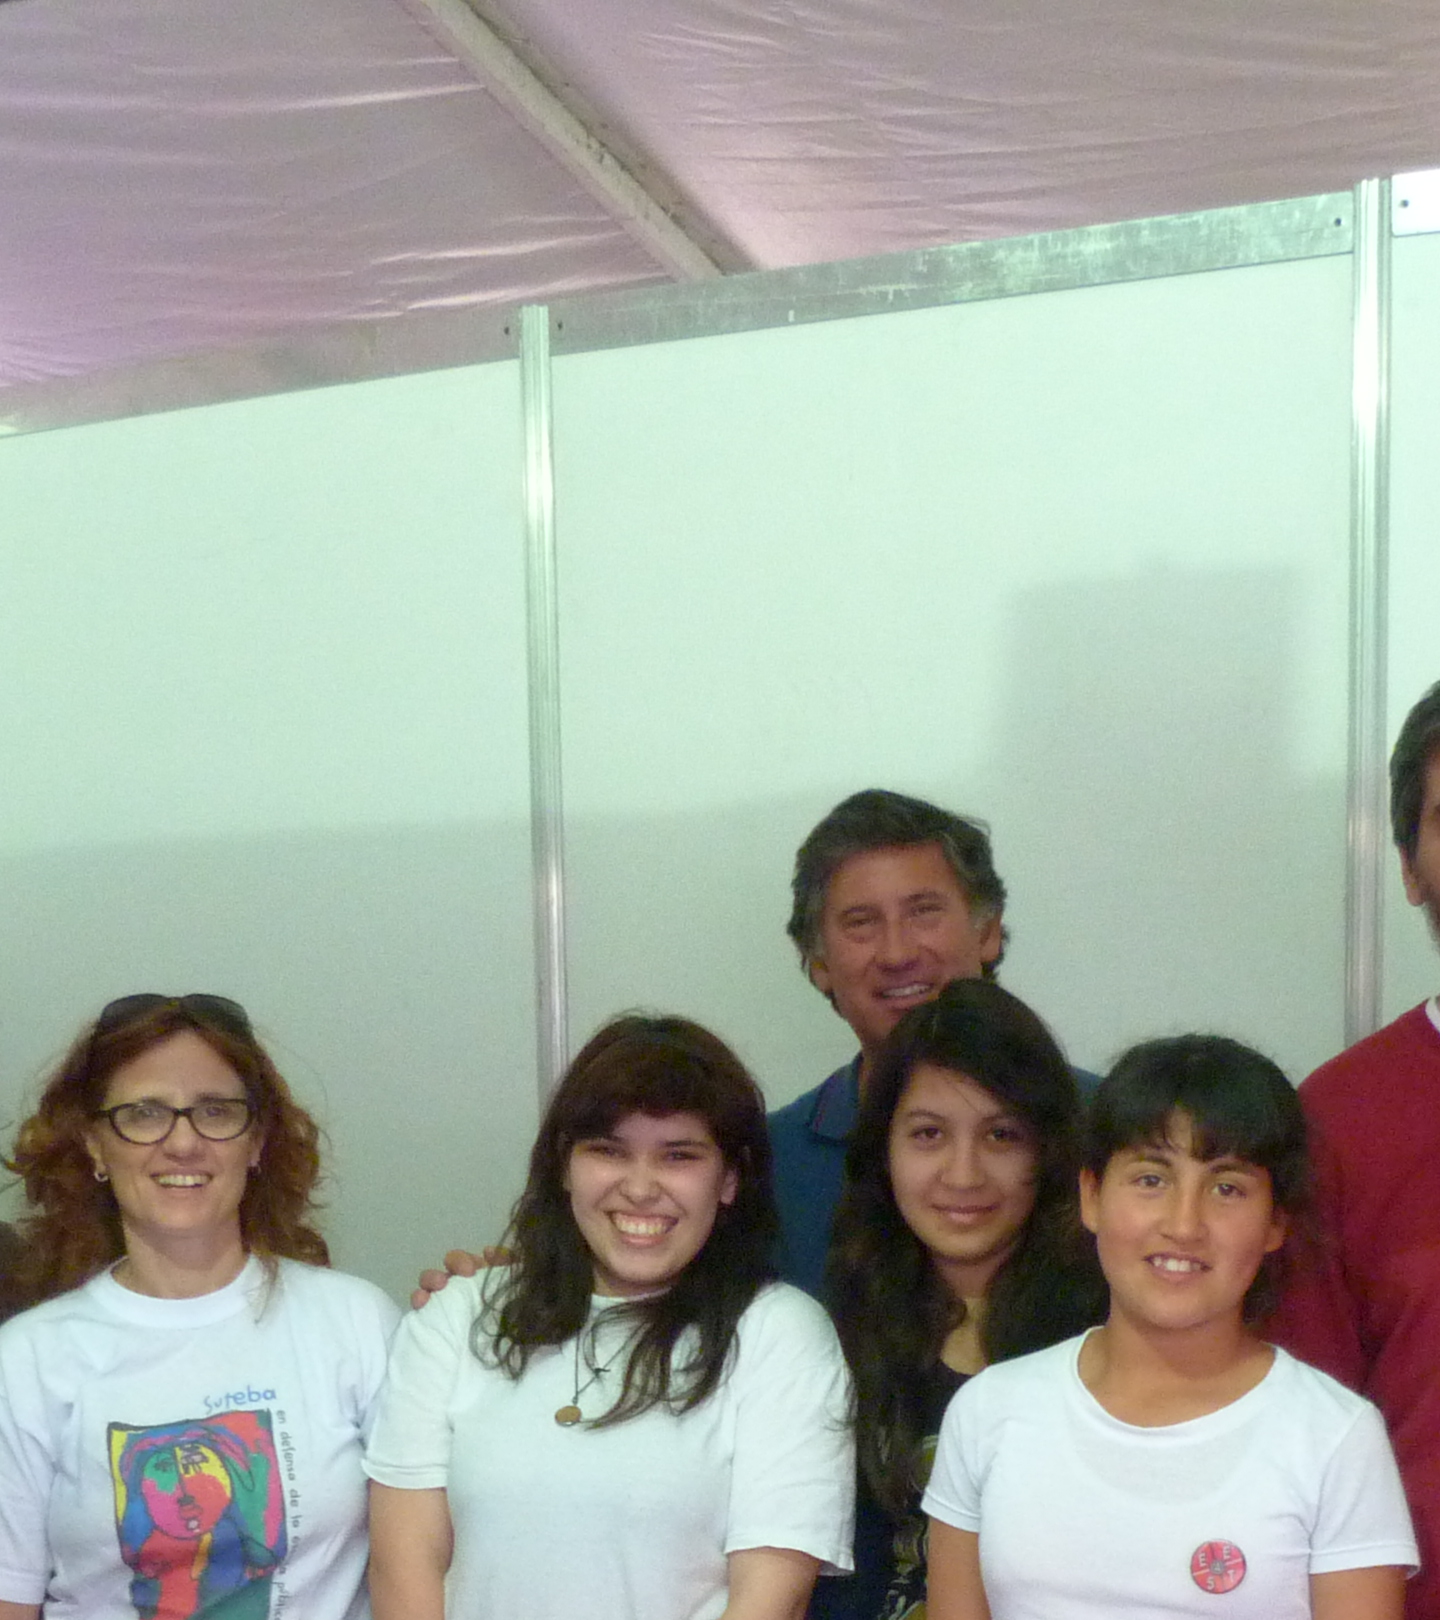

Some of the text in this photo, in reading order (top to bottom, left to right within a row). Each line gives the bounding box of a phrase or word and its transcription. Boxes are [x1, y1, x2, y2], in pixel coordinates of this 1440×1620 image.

[203, 1385, 277, 1415] Suteba
[276, 1409, 287, 1424] en
[280, 1431, 296, 1481] defensa
[289, 1488, 303, 1508] de
